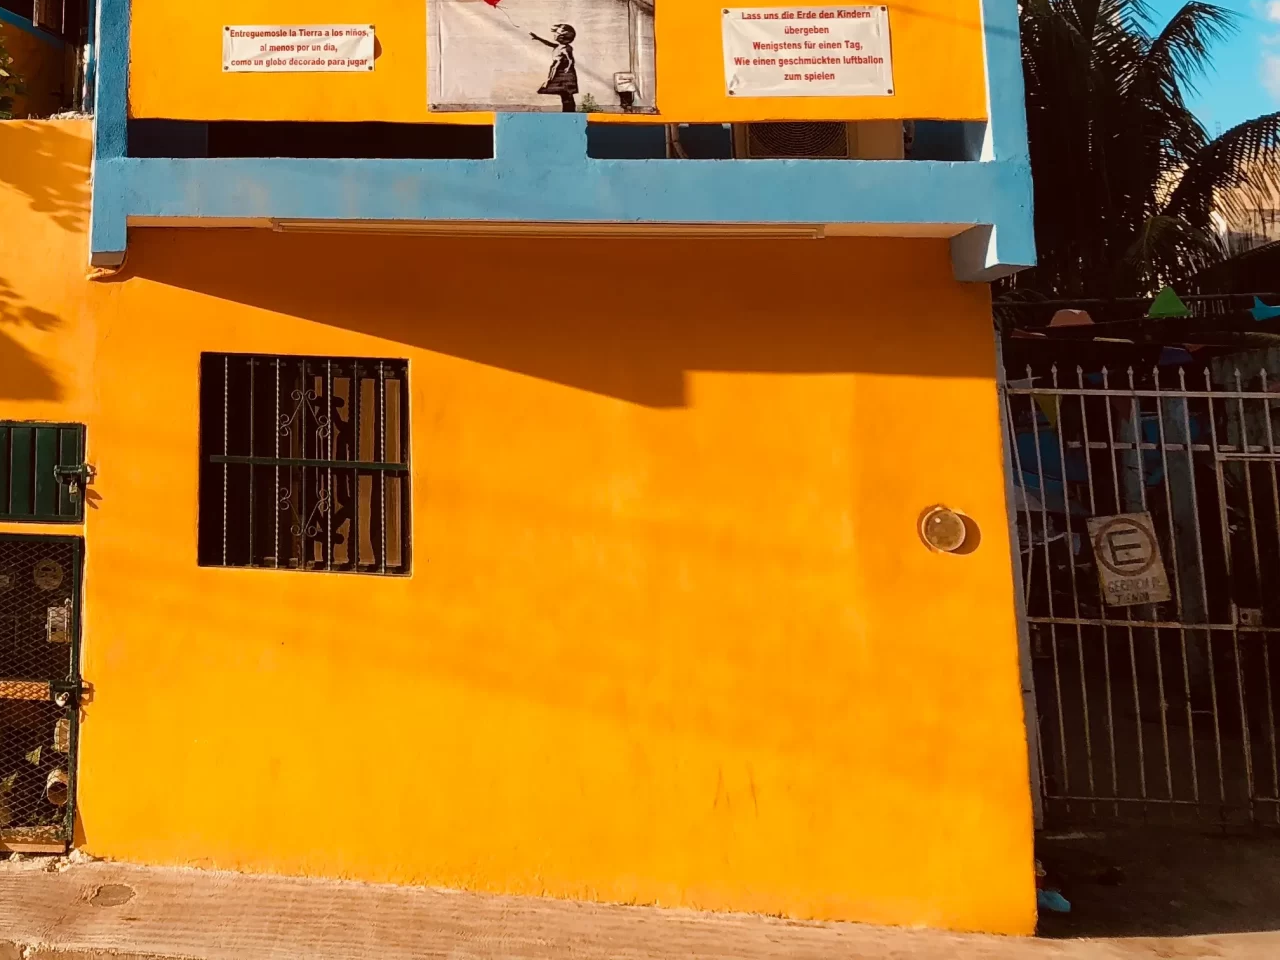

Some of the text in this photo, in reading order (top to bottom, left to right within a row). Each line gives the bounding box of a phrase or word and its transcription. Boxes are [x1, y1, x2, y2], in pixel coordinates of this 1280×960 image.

[741, 12, 761, 20] Lass
[781, 11, 794, 20] die
[797, 10, 816, 19] Erde
[819, 10, 835, 19] den
[837, 9, 871, 18] Kindern
[230, 29, 288, 39] Entreguemosle
[289, 29, 297, 37] la
[299, 29, 323, 37] Tierra
[331, 29, 343, 37] los
[784, 25, 829, 36] übergeben
[260, 43, 267, 51] al
[296, 45, 310, 53] por
[752, 40, 863, 52] Wenigstens für einen Tag,
[266, 58, 287, 67] globo
[289, 58, 325, 66] decorado
[347, 58, 368, 67] jugar
[734, 55, 884, 68] Wie einen geschmückten luftballon
[804, 72, 835, 82] spielen
